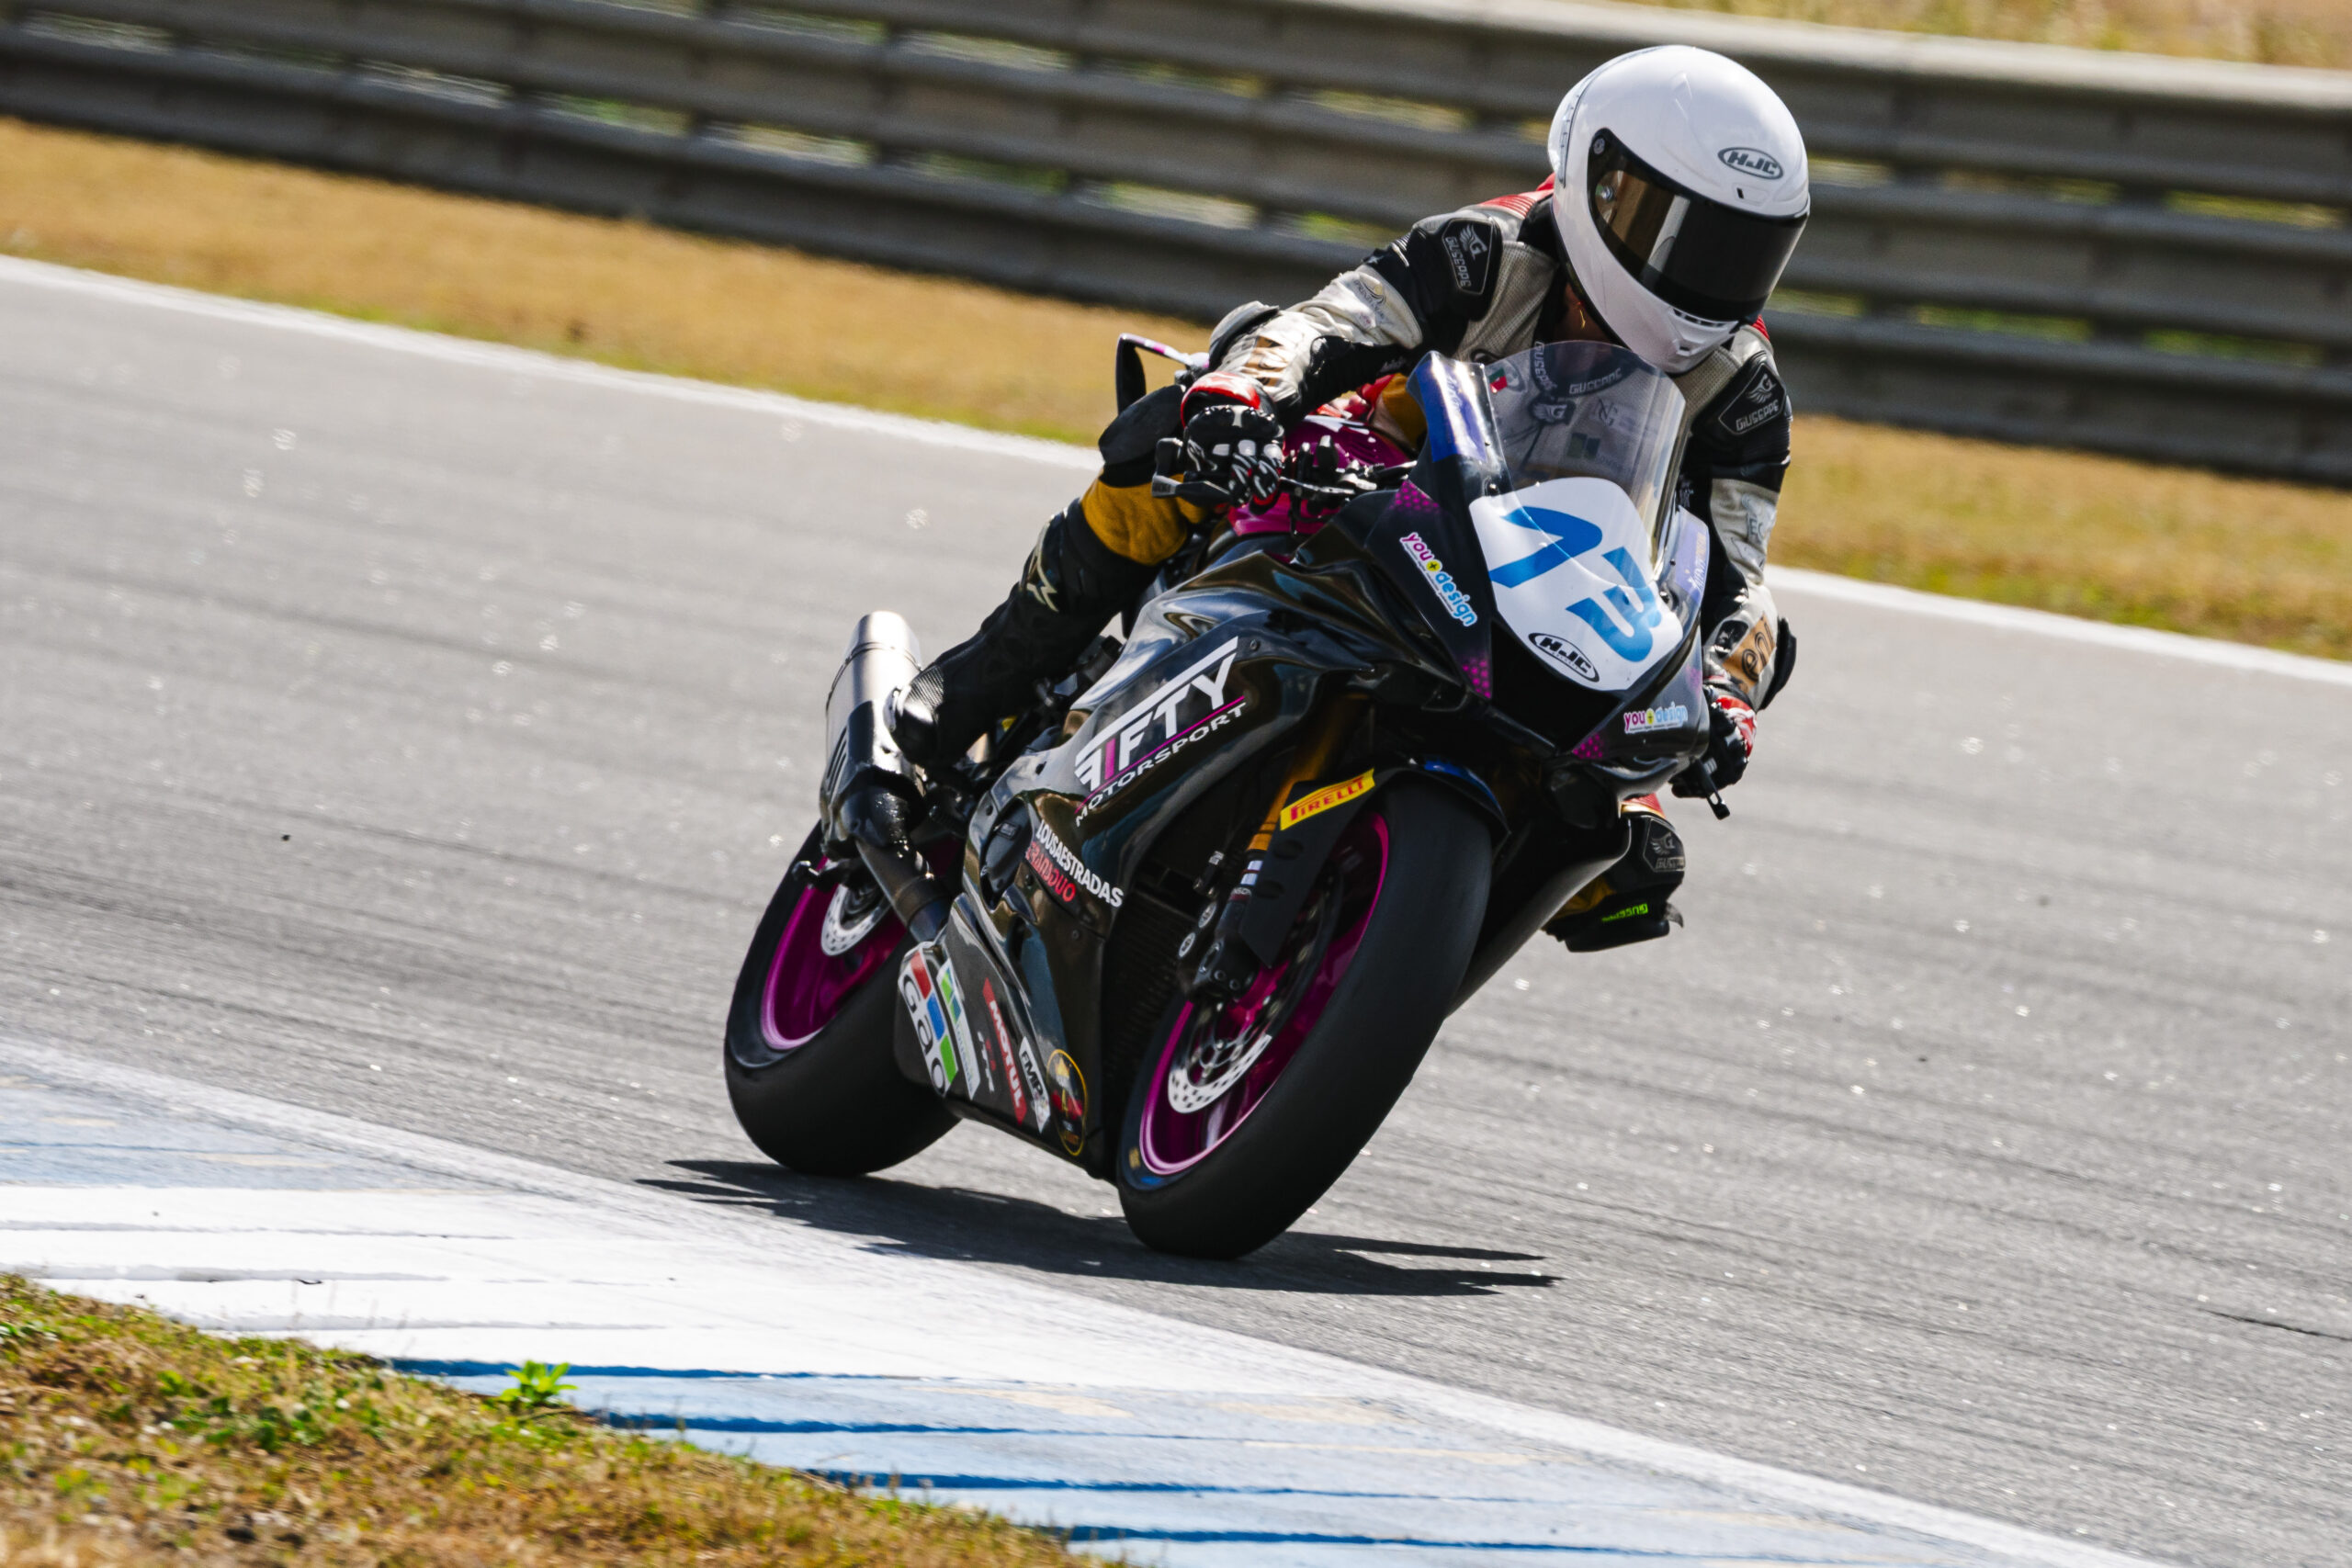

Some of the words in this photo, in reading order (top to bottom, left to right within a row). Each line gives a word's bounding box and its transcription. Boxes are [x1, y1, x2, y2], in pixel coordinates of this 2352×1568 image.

[1728, 151, 1778, 175] HJC
[1488, 505, 1663, 662] 73
[1539, 637, 1591, 673] HJC
[1075, 703, 1247, 827] MOTORSPORT
[1291, 776, 1364, 821] PIRELLI
[1035, 822, 1125, 908] LOUSAESTRADAS
[989, 1000, 1022, 1108] MOTUL
[1021, 1051, 1044, 1096] FMP
